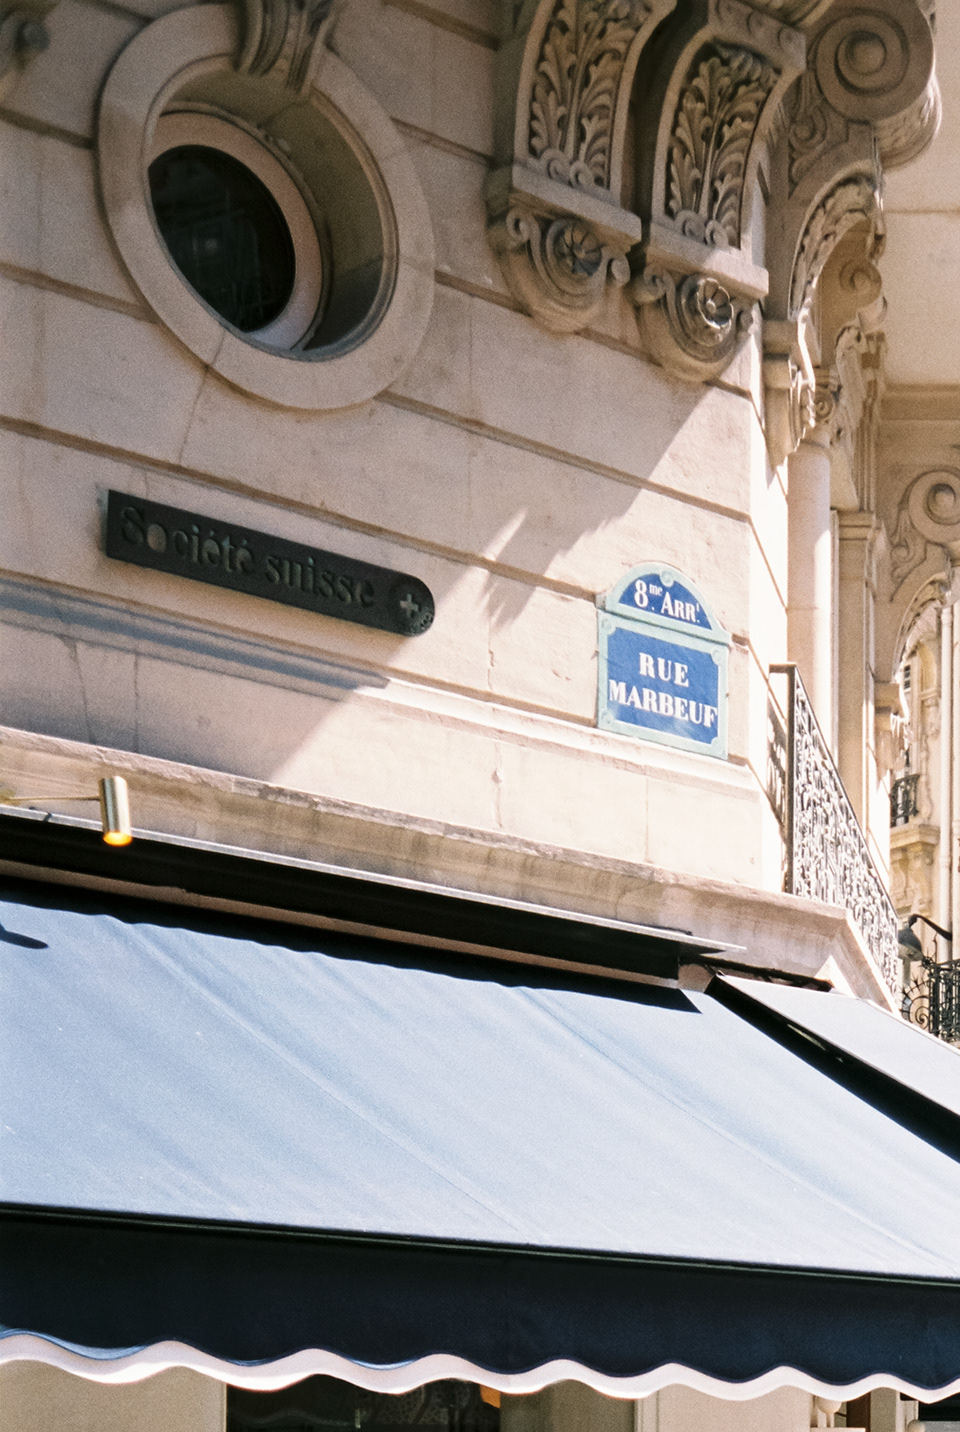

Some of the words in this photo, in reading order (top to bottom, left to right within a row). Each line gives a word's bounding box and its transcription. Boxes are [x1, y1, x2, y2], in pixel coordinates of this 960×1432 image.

[264, 555, 376, 608] suisse
[639, 653, 689, 687] RUE
[609, 680, 717, 727] MARBEUF
